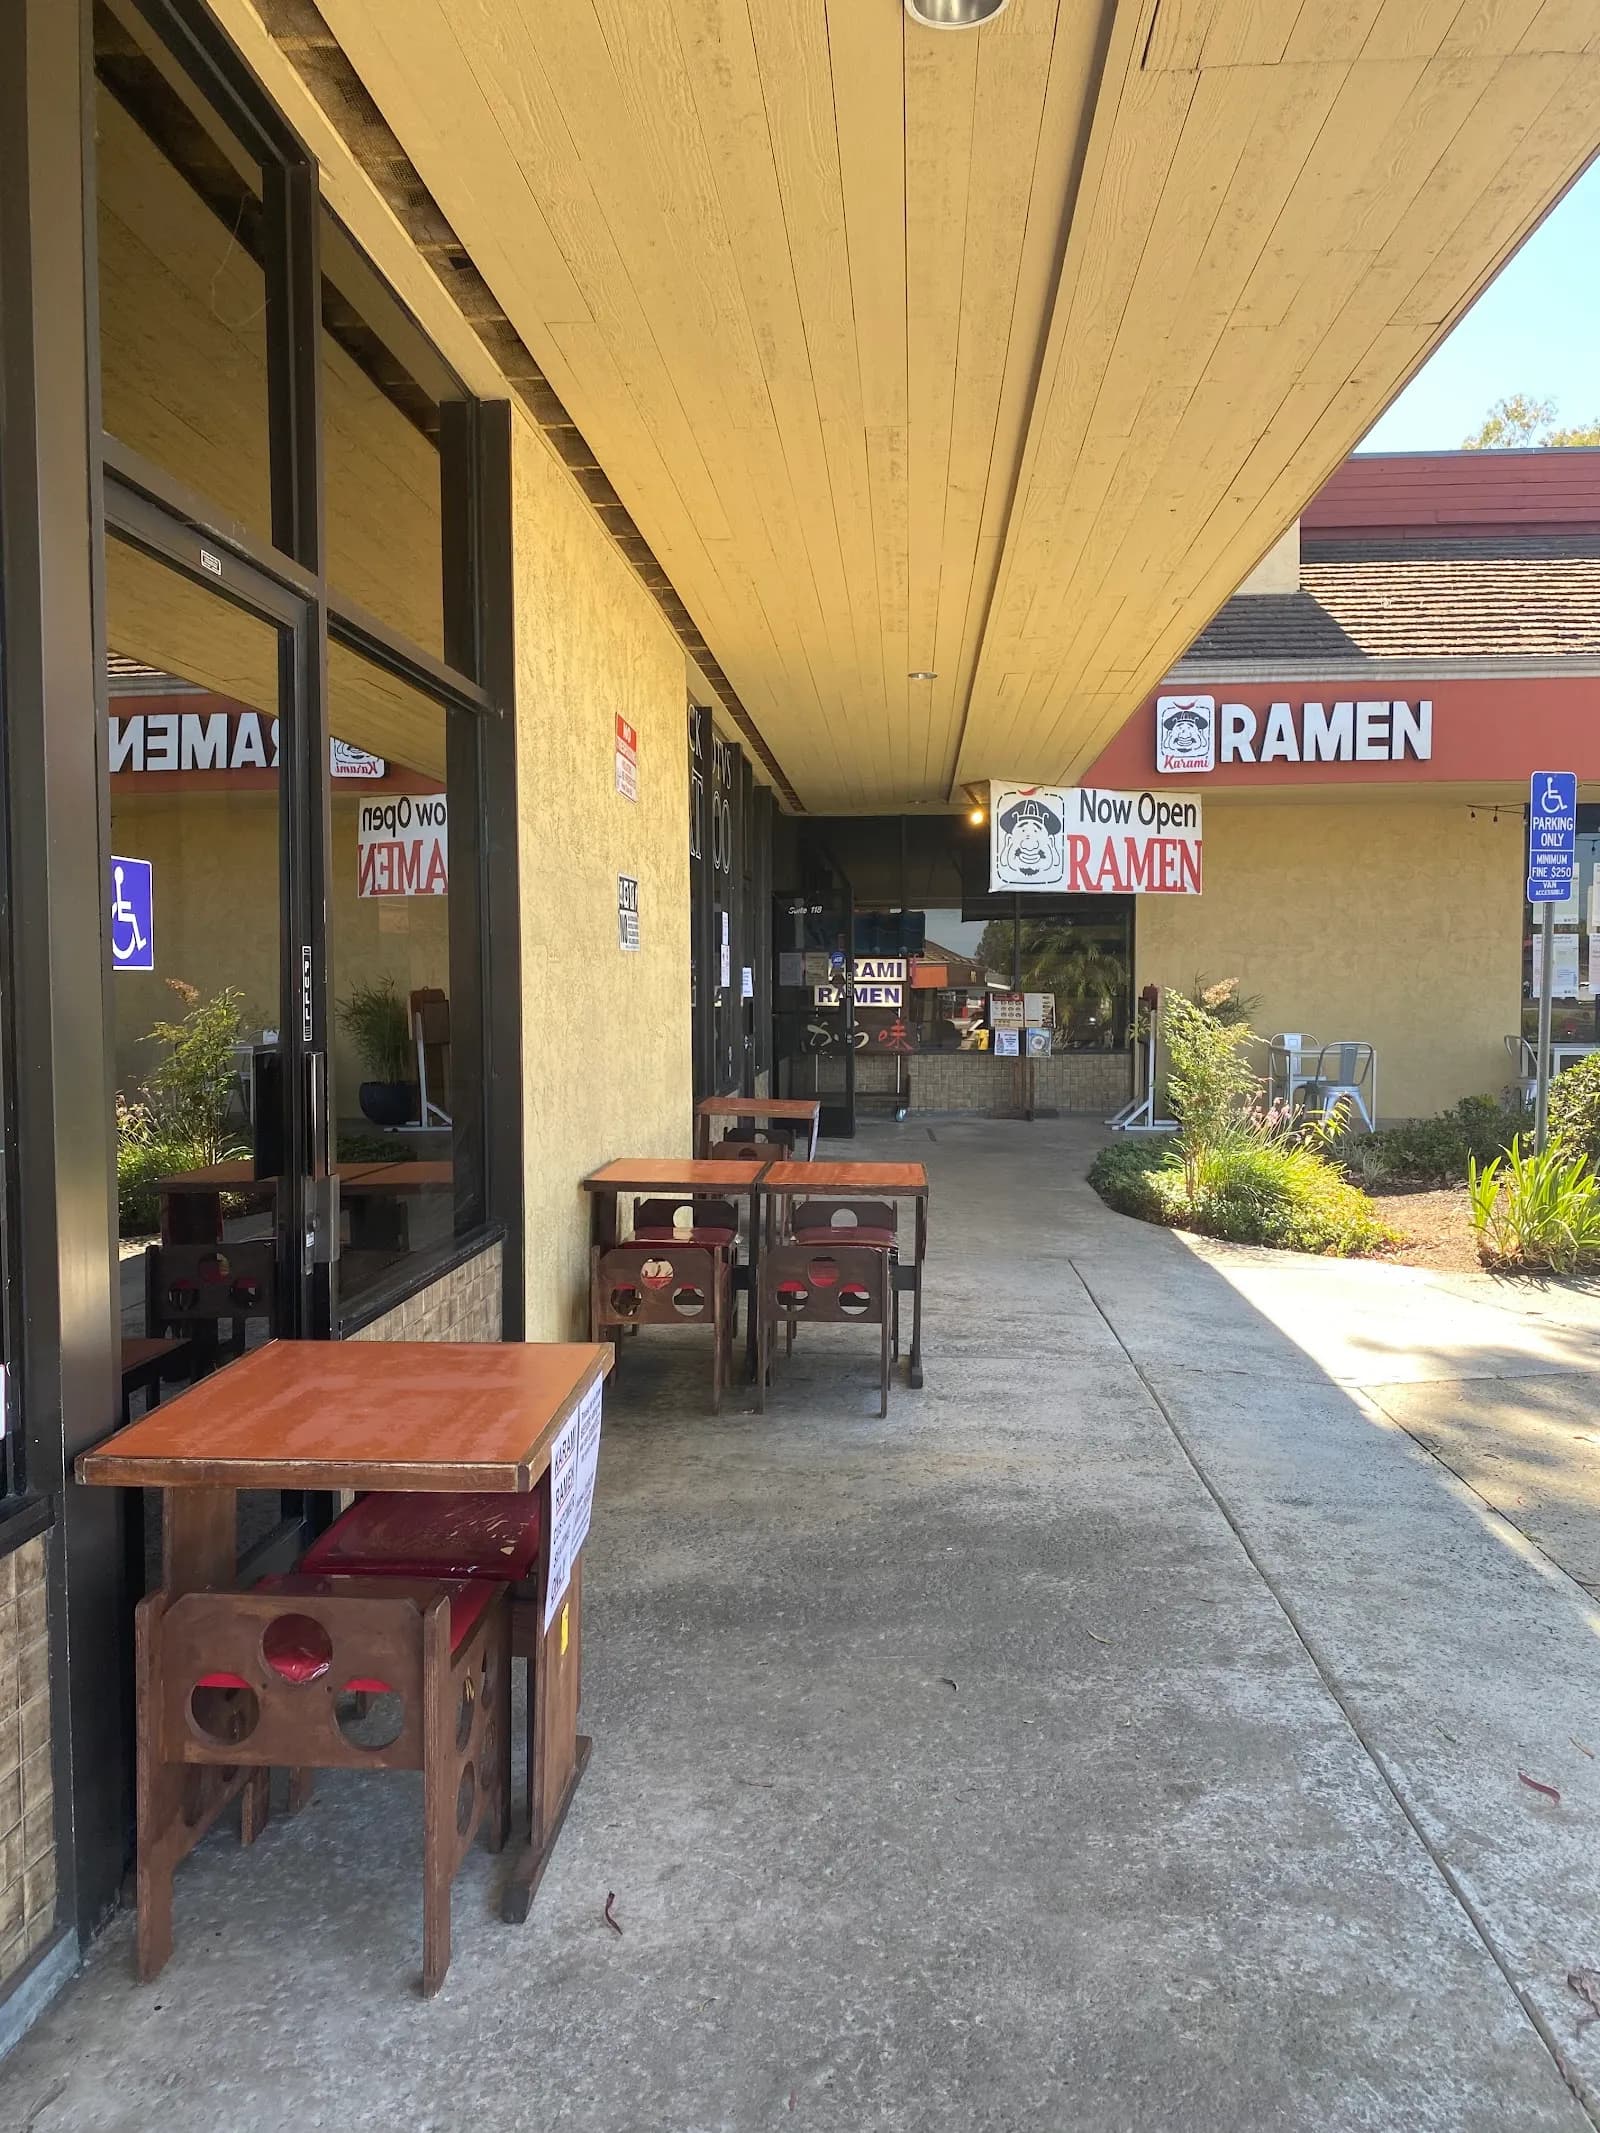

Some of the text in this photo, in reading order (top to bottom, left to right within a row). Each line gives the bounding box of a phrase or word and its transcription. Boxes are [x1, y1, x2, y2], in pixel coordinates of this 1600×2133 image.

[1220, 700, 1433, 763] RAMEN
[1163, 754, 1209, 770] Karami
[1079, 789, 1197, 835] Now Open
[1533, 816, 1573, 831] PARKING
[1541, 833, 1564, 847] ONLY
[1066, 834, 1202, 894] RAMEN
[1536, 854, 1568, 865] MINIMUM
[1532, 866, 1572, 879] FINE $250
[1543, 880, 1557, 889] VAN
[788, 905, 823, 915] Suite 118
